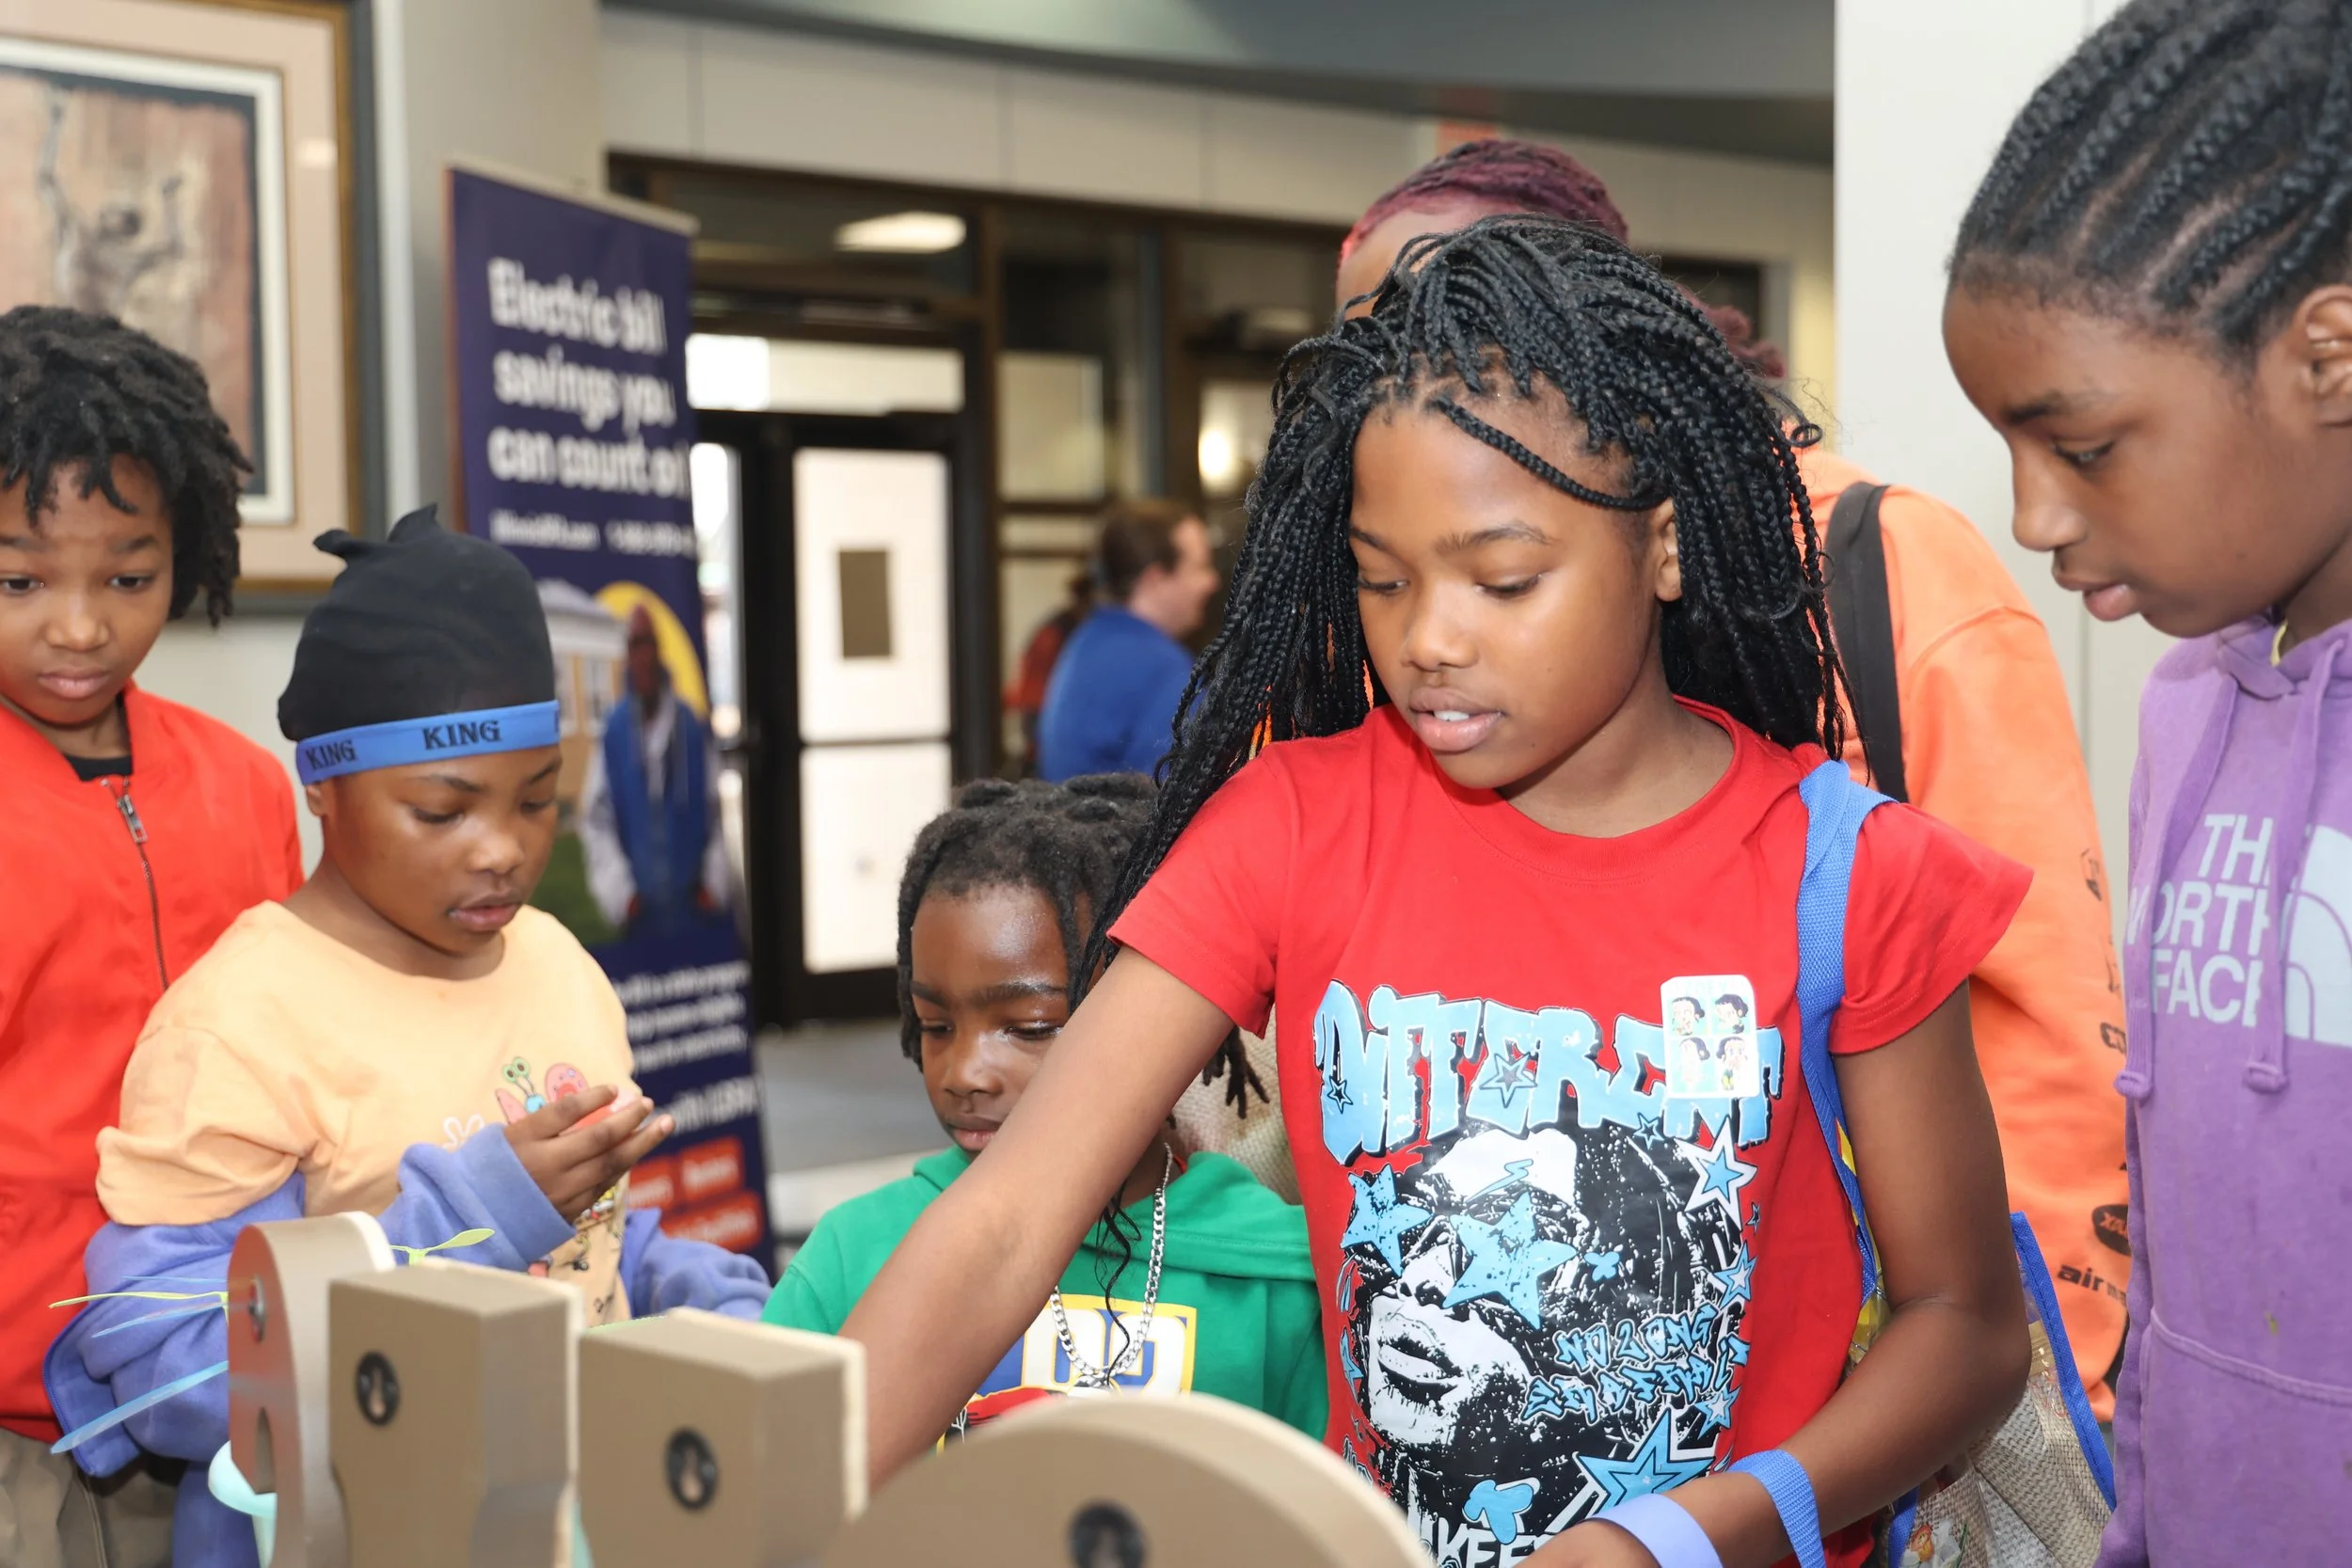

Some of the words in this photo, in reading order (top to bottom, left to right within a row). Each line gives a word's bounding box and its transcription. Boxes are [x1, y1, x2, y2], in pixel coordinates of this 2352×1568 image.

[494, 345, 621, 431] savings
[622, 373, 676, 436] you
[488, 426, 556, 483] can
[305, 739, 357, 770] KING
[423, 719, 502, 750] KING
[2198, 814, 2274, 887] TH
